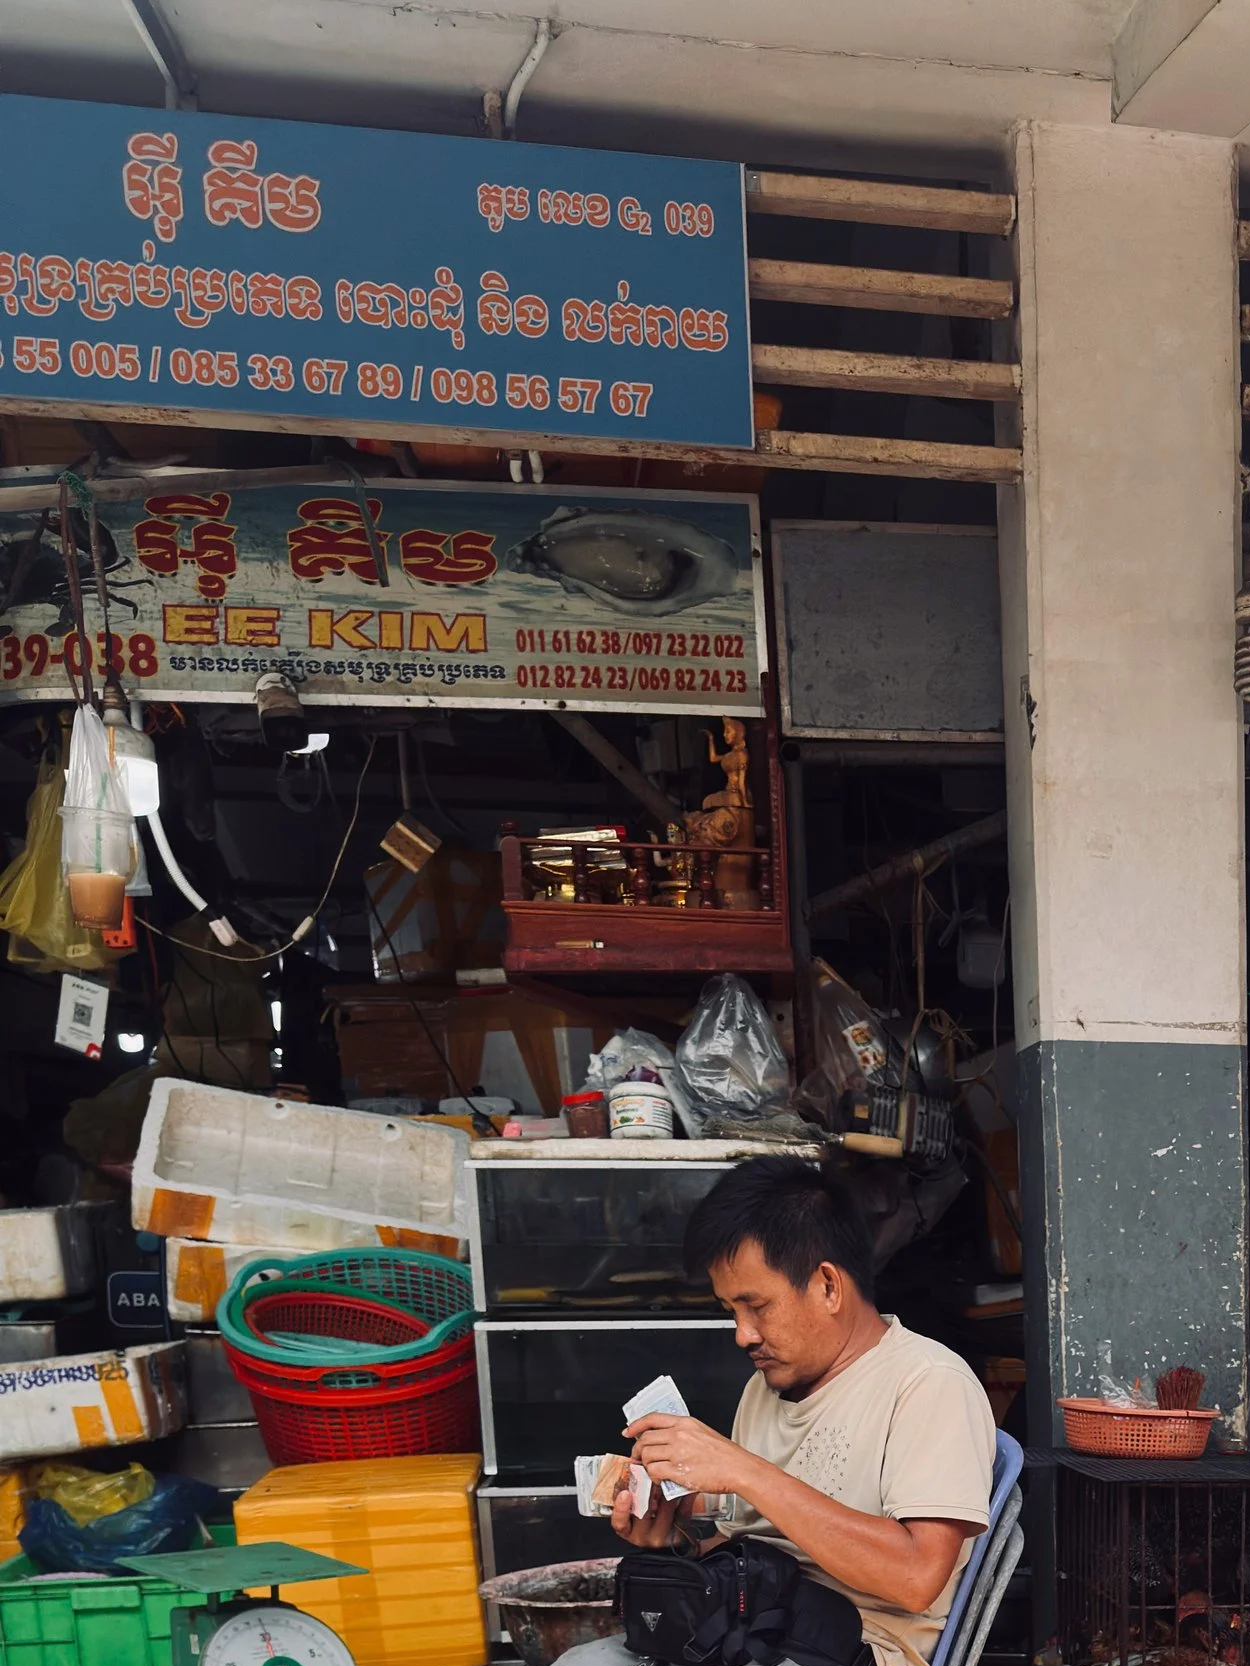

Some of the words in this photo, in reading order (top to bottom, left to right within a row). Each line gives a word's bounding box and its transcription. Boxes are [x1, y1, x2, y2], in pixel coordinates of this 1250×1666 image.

[664, 200, 714, 238] 039
[13, 336, 61, 375] 55
[69, 340, 141, 381] 005
[169, 348, 239, 388] 085
[247, 353, 295, 392] 33
[302, 358, 348, 395] 67
[357, 362, 402, 400] 89
[430, 368, 498, 406] 098
[506, 373, 550, 411] 56
[557, 377, 602, 414] 57
[609, 381, 654, 417] 67
[162, 604, 281, 646] EE
[308, 608, 488, 653] KIM
[515, 628, 546, 653] 011
[552, 629, 571, 654] 61
[576, 629, 597, 654] 62
[666, 632, 687, 656] 23
[690, 633, 711, 657] 22
[714, 633, 744, 659] 022
[516, 664, 550, 688] 012
[554, 664, 576, 689] 82
[580, 665, 601, 689] 24
[675, 667, 697, 691] 82
[700, 668, 722, 692] 24
[725, 669, 747, 693] 23
[116, 1292, 161, 1307] ABA
[309, 1649, 316, 1658] 5
